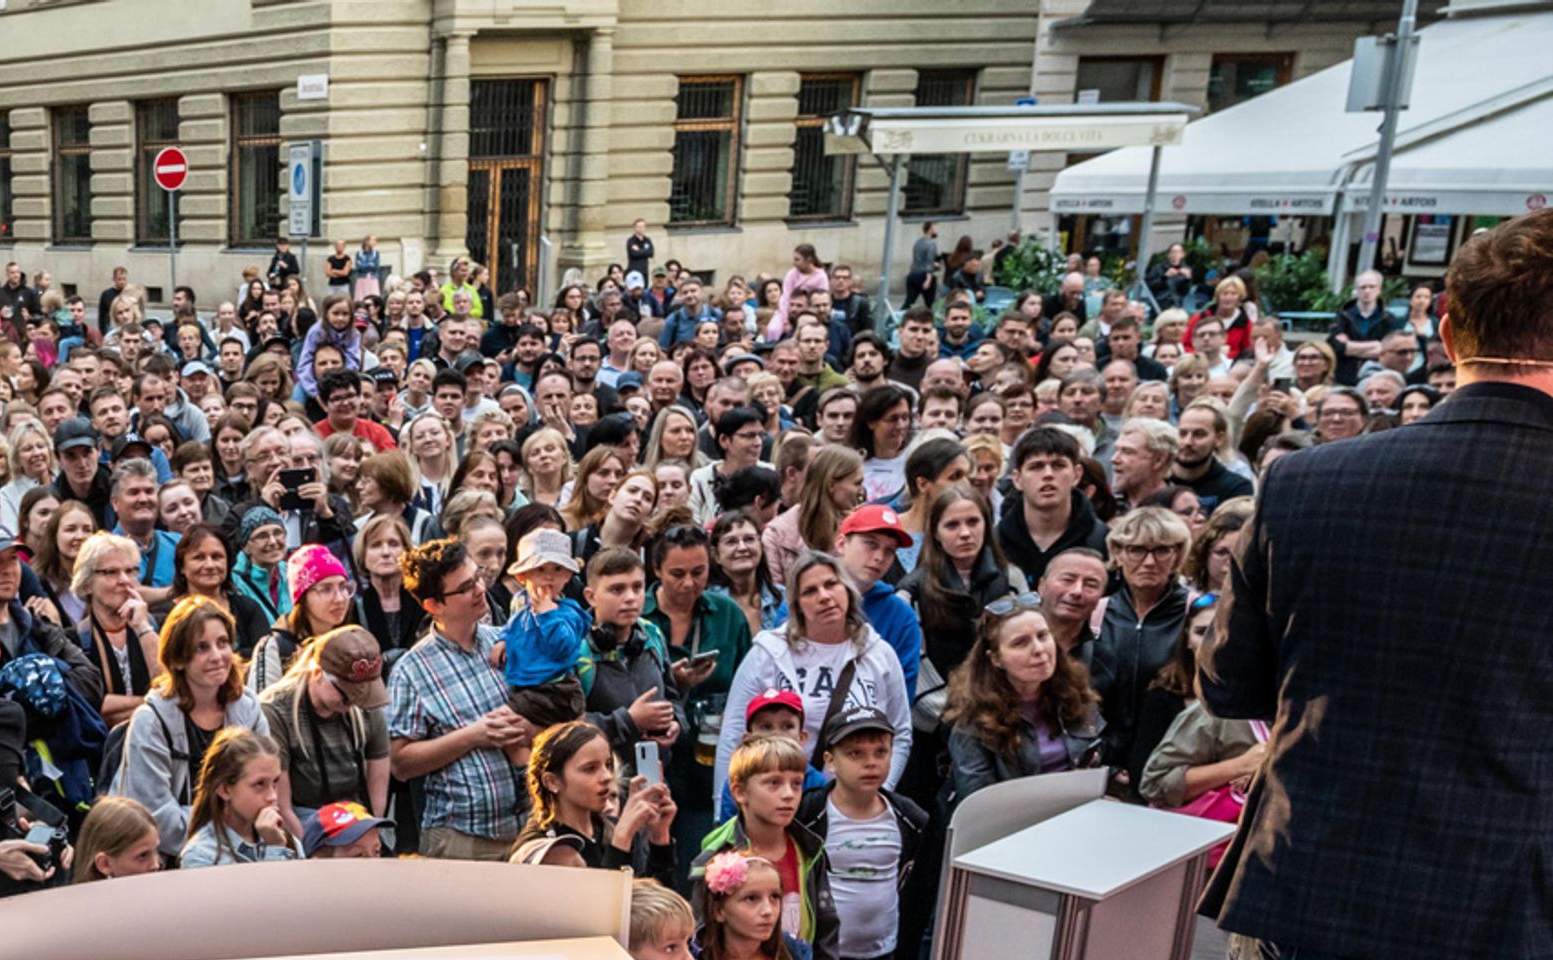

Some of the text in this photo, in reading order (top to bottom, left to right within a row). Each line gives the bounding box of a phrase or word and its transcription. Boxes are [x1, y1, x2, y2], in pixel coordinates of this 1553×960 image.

[1250, 199, 1323, 208] STELLA ARTOIS
[1400, 197, 1437, 207] ARTOIS
